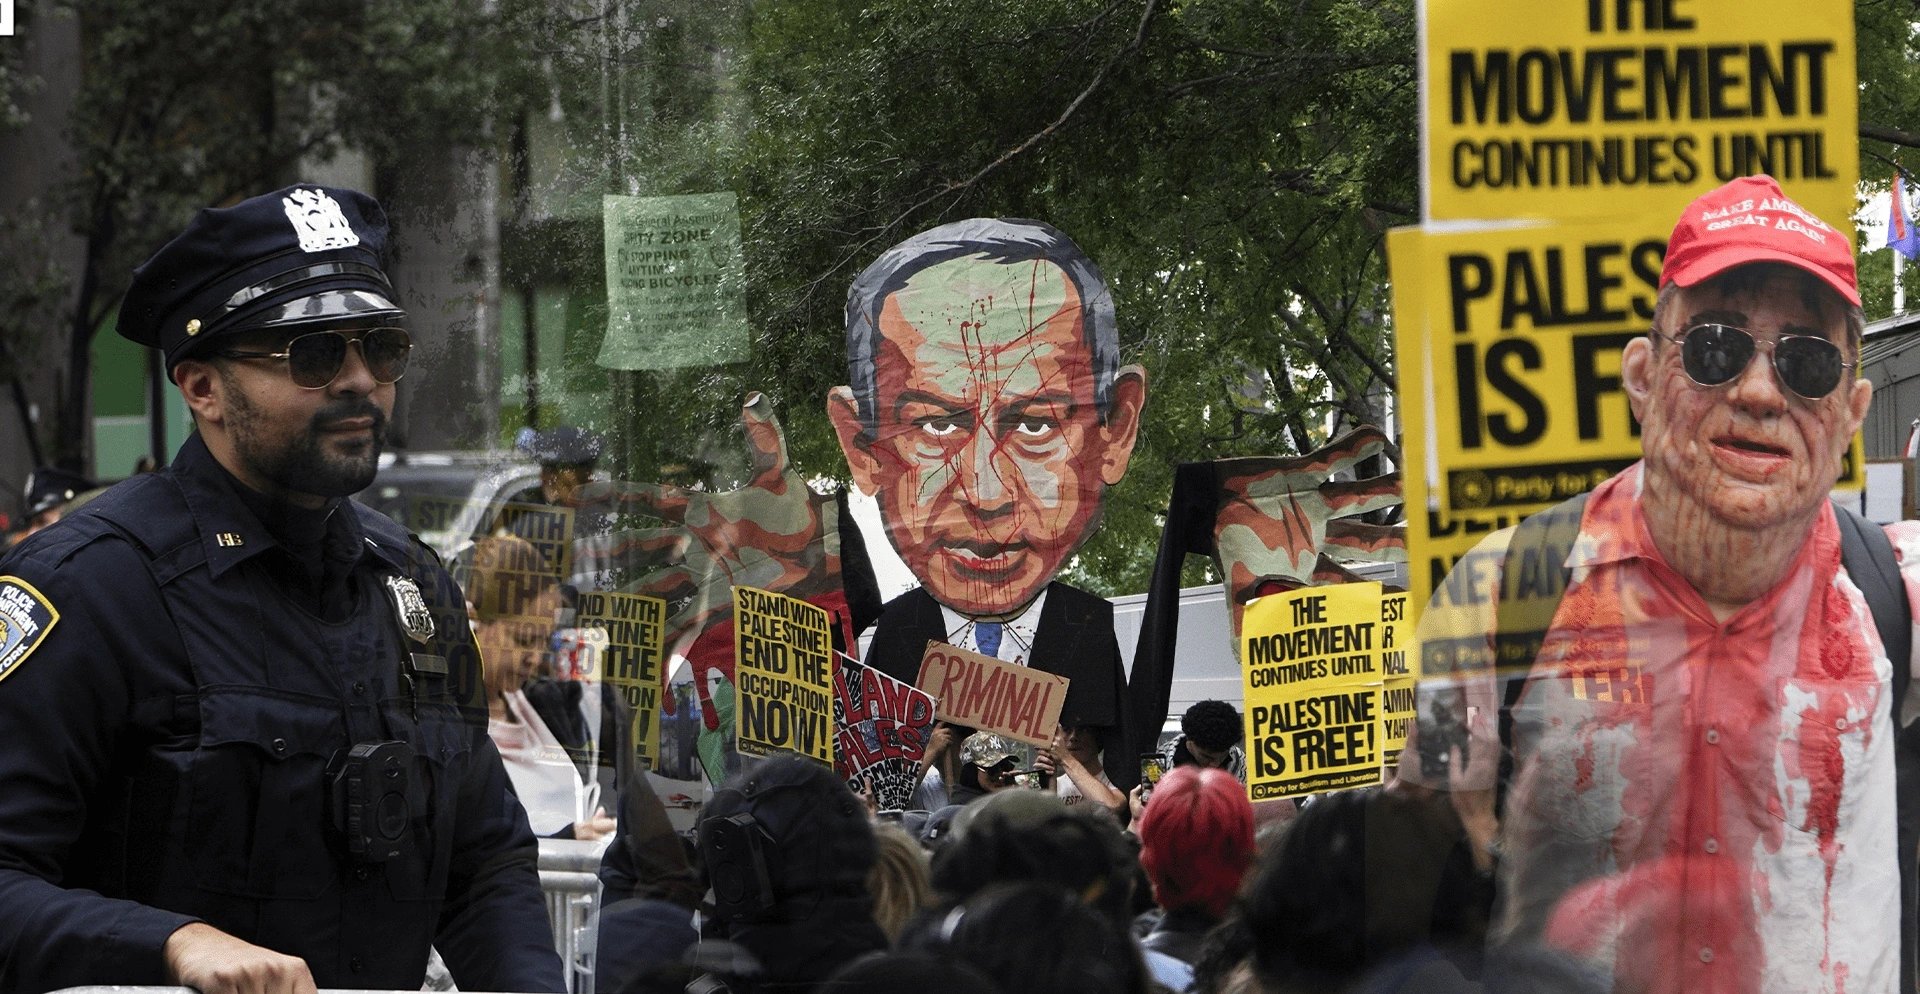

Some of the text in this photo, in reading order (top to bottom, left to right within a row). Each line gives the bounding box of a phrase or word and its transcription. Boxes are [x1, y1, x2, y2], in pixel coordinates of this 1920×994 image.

[1449, 42, 1835, 126] MOVEMENT
[1451, 130, 1837, 189] CONTINUES UNTIL
[1702, 198, 1833, 233] MAKE AMERICA
[1707, 214, 1827, 245] GREAT AGAIN
[660, 228, 713, 245] ZONE
[649, 274, 722, 289] BICYCLES
[1448, 240, 1668, 334] PALES
[1453, 337, 1548, 453] IS
[508, 508, 566, 541] WITH
[0, 598, 39, 637] ARTMENT
[1, 585, 36, 614] POLICE
[578, 594, 660, 623] ND WITH
[739, 588, 827, 631] STAND WITH
[1289, 595, 1328, 627] THE
[580, 618, 658, 647] ESTINE!
[740, 610, 828, 656] PALESTINE!
[1248, 622, 1375, 666] MOVEMENT
[605, 644, 657, 682] THE
[740, 634, 787, 675] END
[792, 648, 829, 688] THE
[1250, 655, 1376, 688] CONTINUES UNTIL
[740, 671, 829, 715] OCCUPATION
[917, 651, 1054, 740] CRIMINAL
[741, 693, 827, 759] NOW!
[1252, 691, 1375, 737] PALESTINE
[1253, 723, 1375, 778] IS FREE!
[1267, 784, 1286, 795] Party
[1287, 783, 1298, 792] for
[1330, 776, 1345, 786] and
[1345, 772, 1379, 785] Liberation
